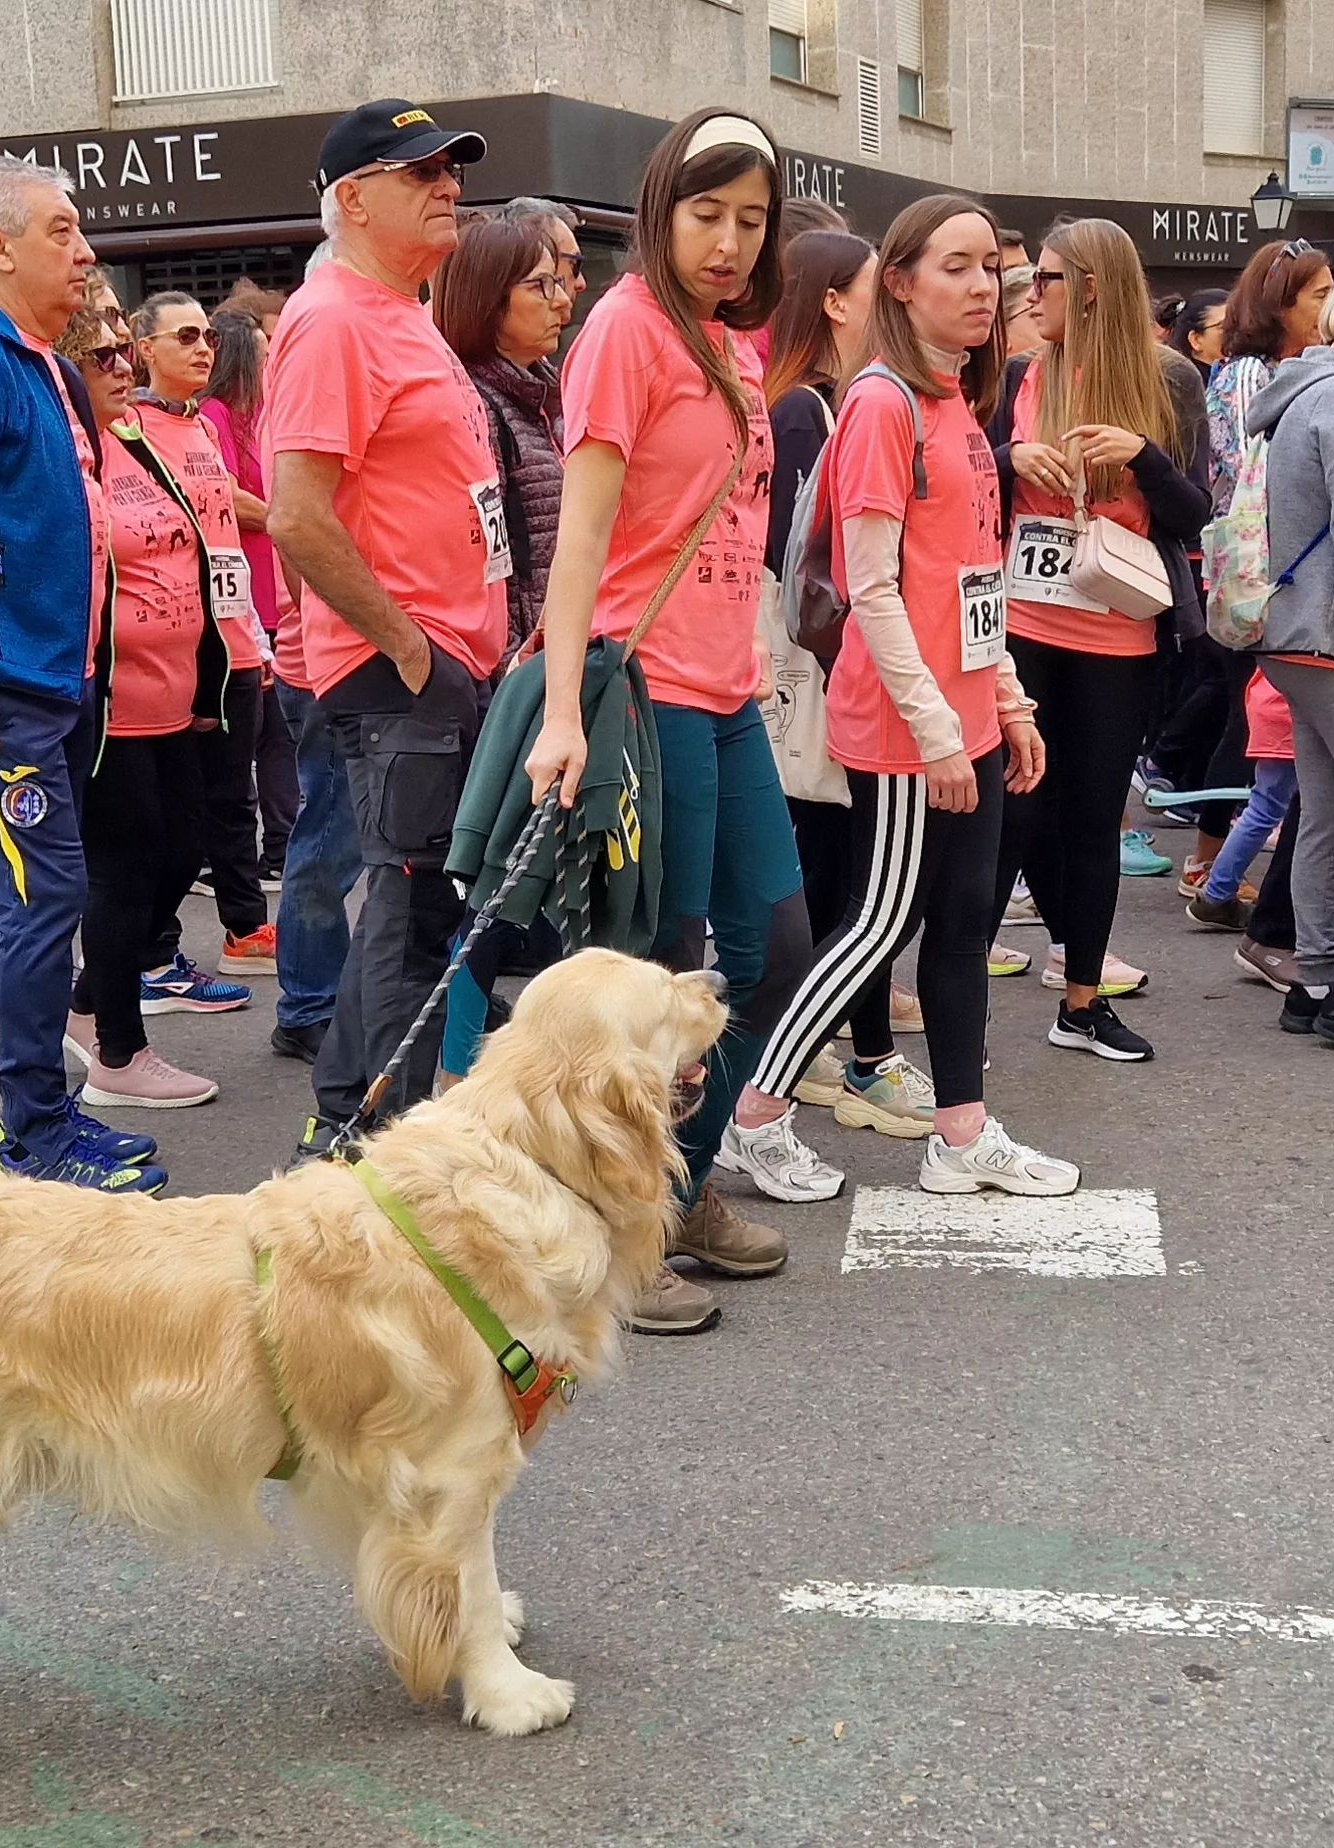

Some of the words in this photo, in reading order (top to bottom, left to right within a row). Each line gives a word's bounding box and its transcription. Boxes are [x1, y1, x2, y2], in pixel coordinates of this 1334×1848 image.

[785, 156, 845, 208] IRATE
[87, 201, 177, 220] NSWEAR
[1153, 208, 1248, 243] MIRATE
[1174, 251, 1230, 262] MENSWEAR
[1024, 532, 1058, 542] CONTRA
[1061, 536, 1070, 545] EL
[212, 572, 237, 598] 15
